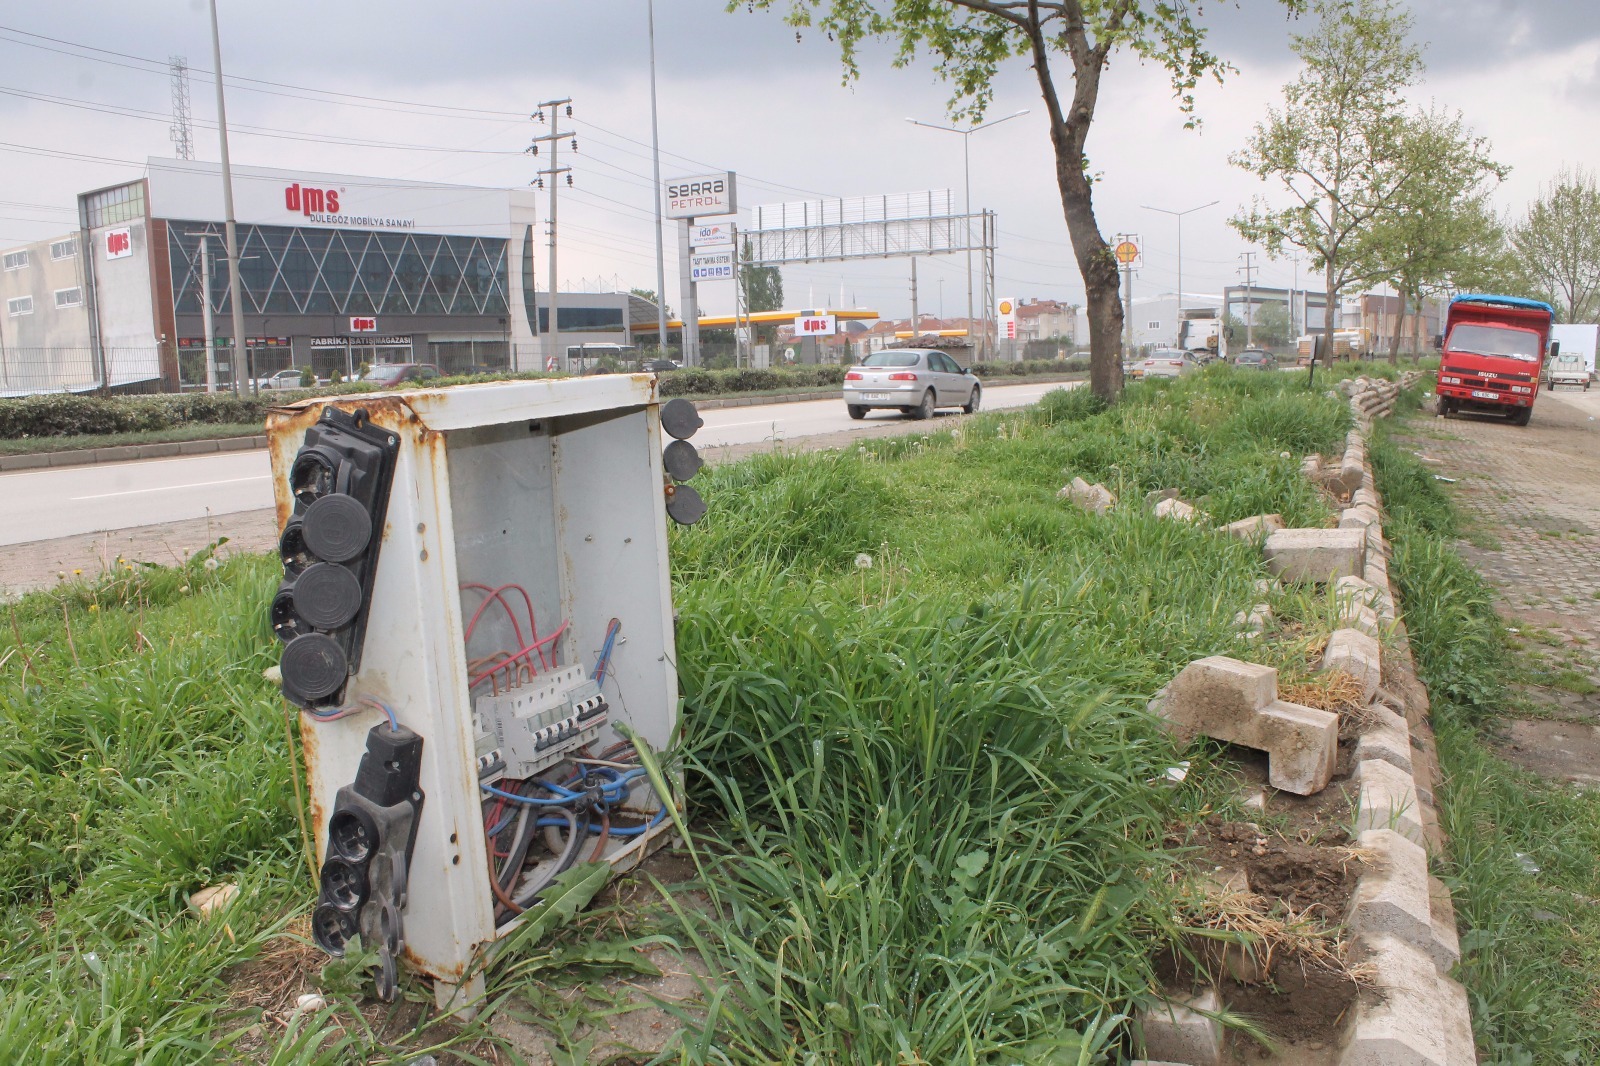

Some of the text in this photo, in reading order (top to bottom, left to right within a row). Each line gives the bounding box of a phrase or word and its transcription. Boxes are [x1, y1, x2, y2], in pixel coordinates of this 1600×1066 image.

[285, 183, 340, 216] dms
[671, 196, 721, 209] PETROL
[699, 227, 711, 237] ido
[803, 319, 827, 333] dms
[1477, 370, 1498, 379] ISUZU
